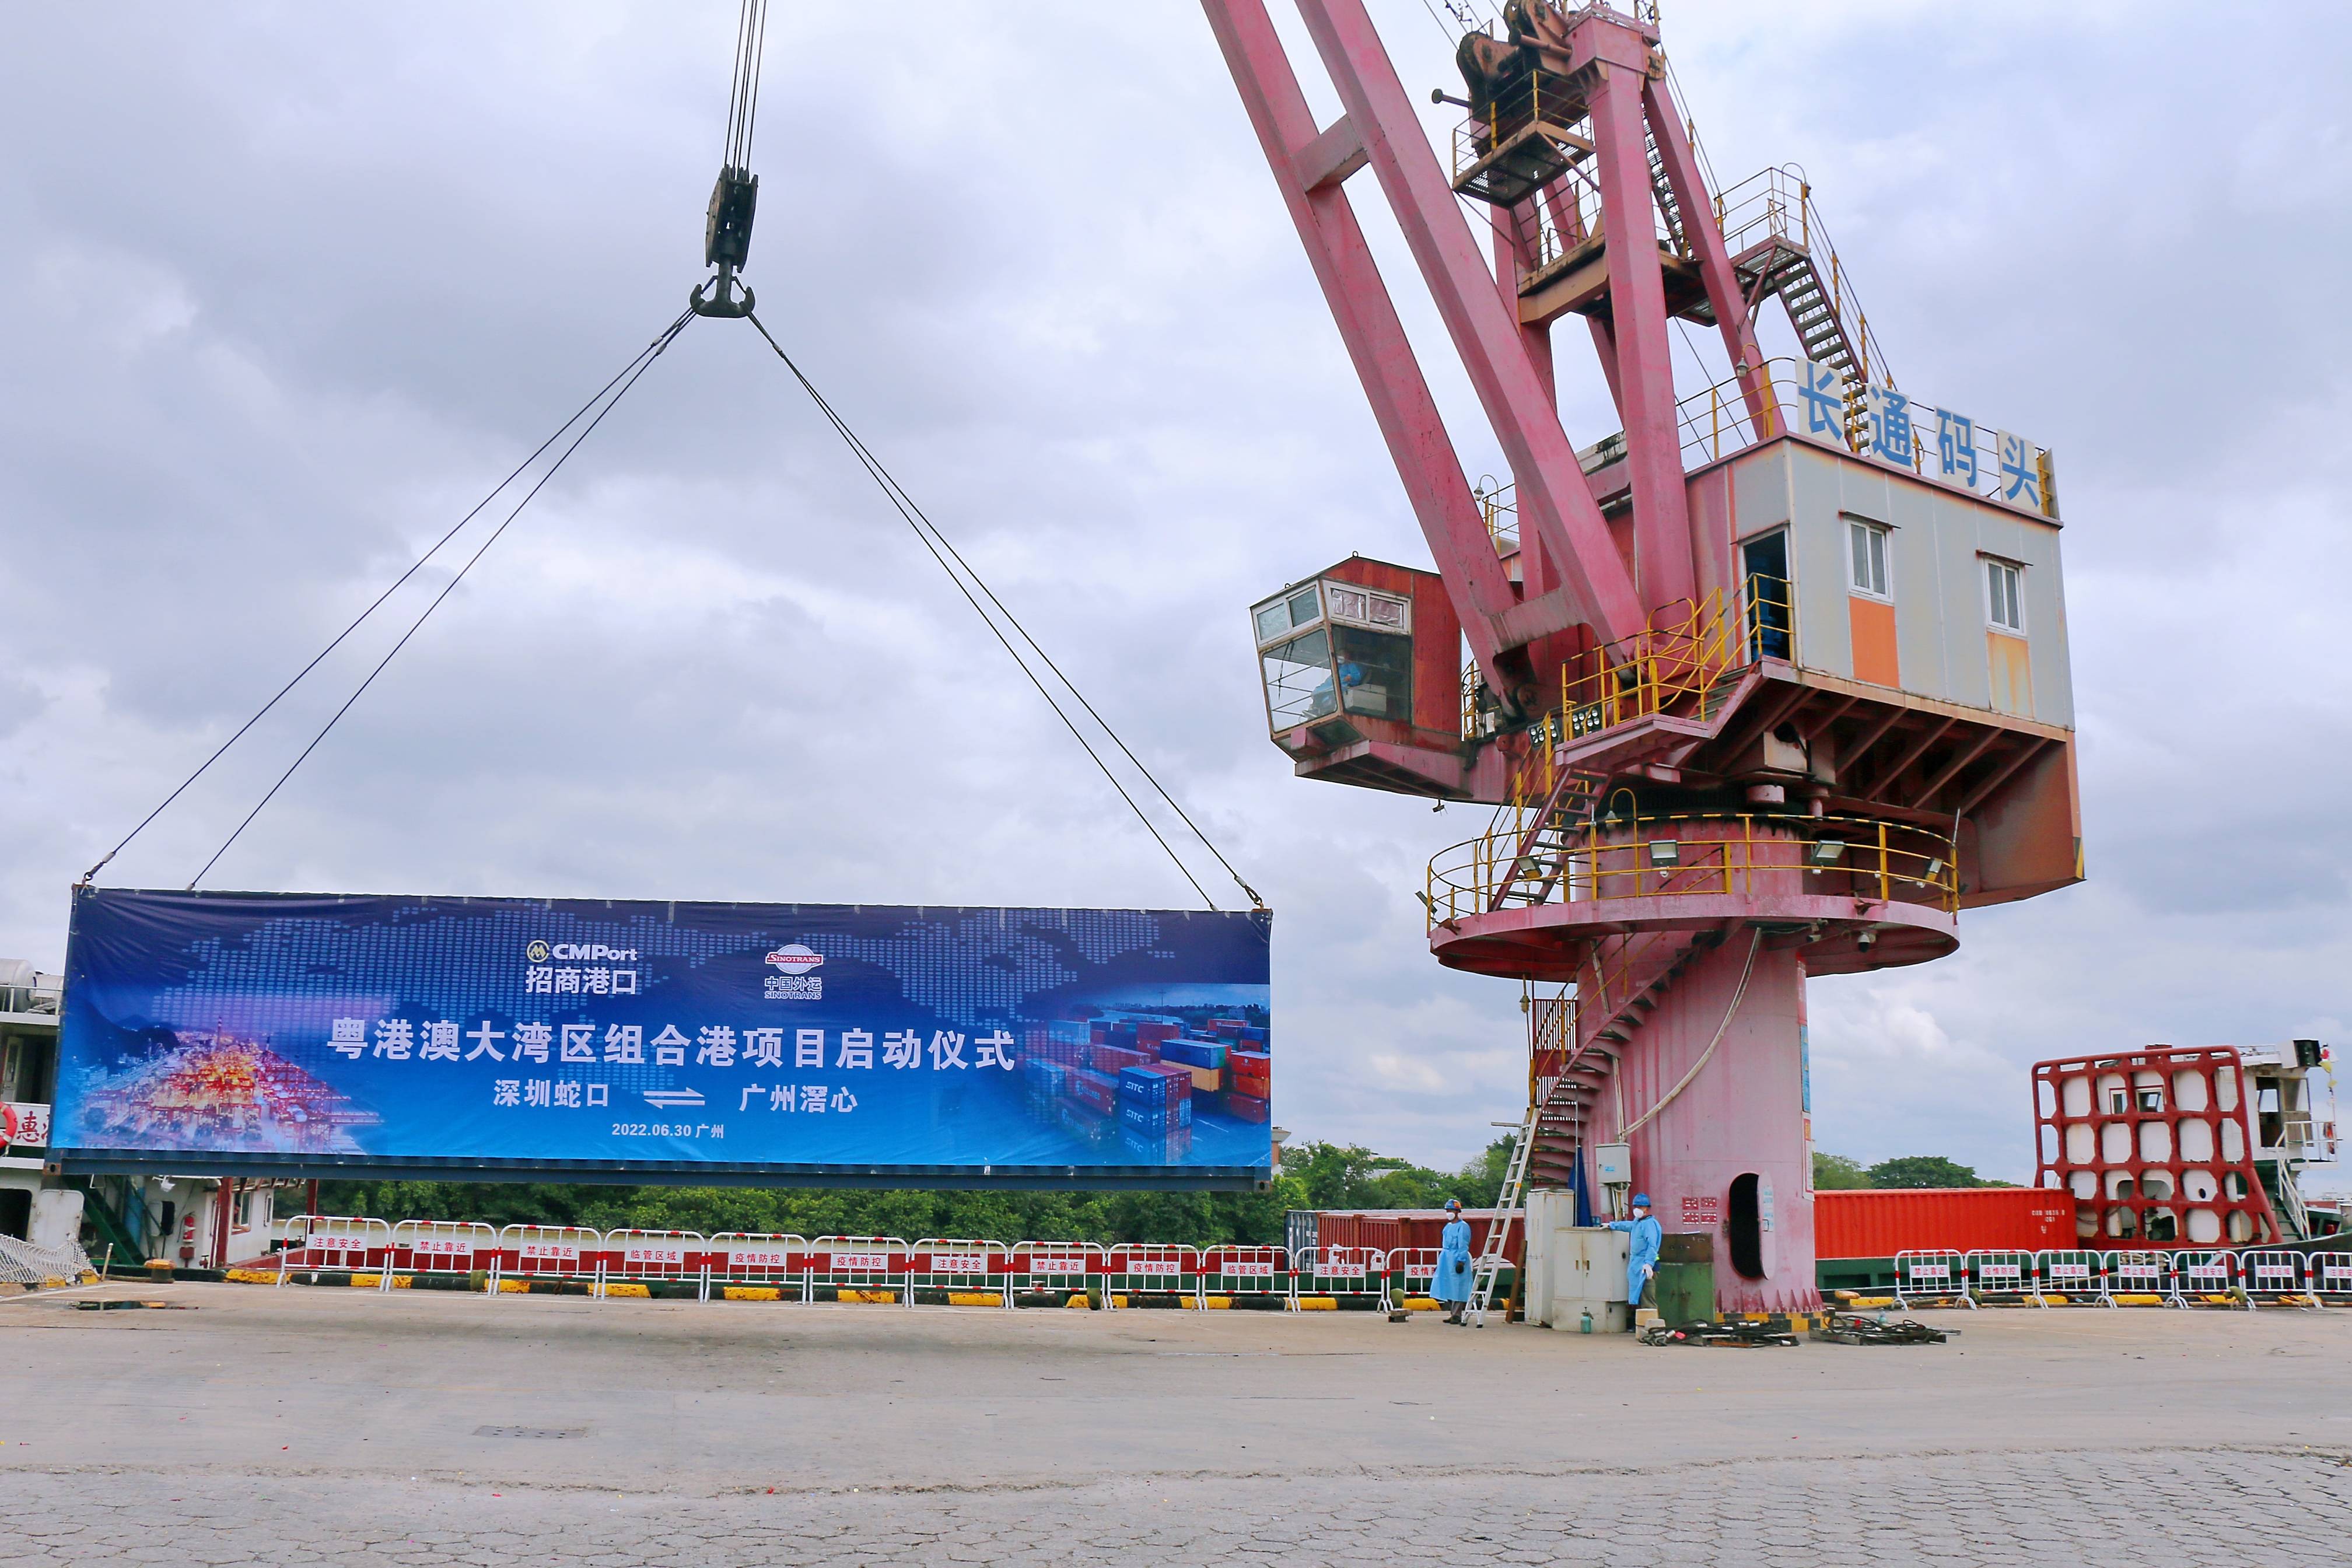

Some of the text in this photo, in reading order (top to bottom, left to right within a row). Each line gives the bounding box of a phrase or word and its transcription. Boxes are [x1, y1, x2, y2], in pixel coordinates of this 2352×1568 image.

[1798, 362, 2039, 508] 长通码头
[553, 944, 638, 961] CMPort
[768, 954, 821, 963] SINOTRANS
[526, 965, 636, 994] 招商港口
[765, 976, 822, 991] 中国外运
[765, 991, 821, 1000] SINOTRANS
[327, 1017, 1015, 1071] 粤港澳大湾区组合港项目启动仪式
[494, 1079, 858, 1113] 深圳蛇口 广州滘心
[612, 1124, 724, 1139] 2022.06.30 广州
[314, 1237, 361, 1250] 注意安全
[419, 1241, 467, 1253] 禁止靠近
[526, 1245, 573, 1257] 禁止靠近
[631, 1250, 677, 1261] 临管区域
[734, 1253, 780, 1264] 疫情防控
[836, 1256, 881, 1267] 疫情防控
[937, 1259, 981, 1270] 注意安全
[1036, 1261, 1079, 1272] 禁止靠近
[1133, 1262, 1175, 1273] 疫情防控
[1227, 1265, 1269, 1275] 临管区域
[1320, 1266, 1361, 1276] 注意安全
